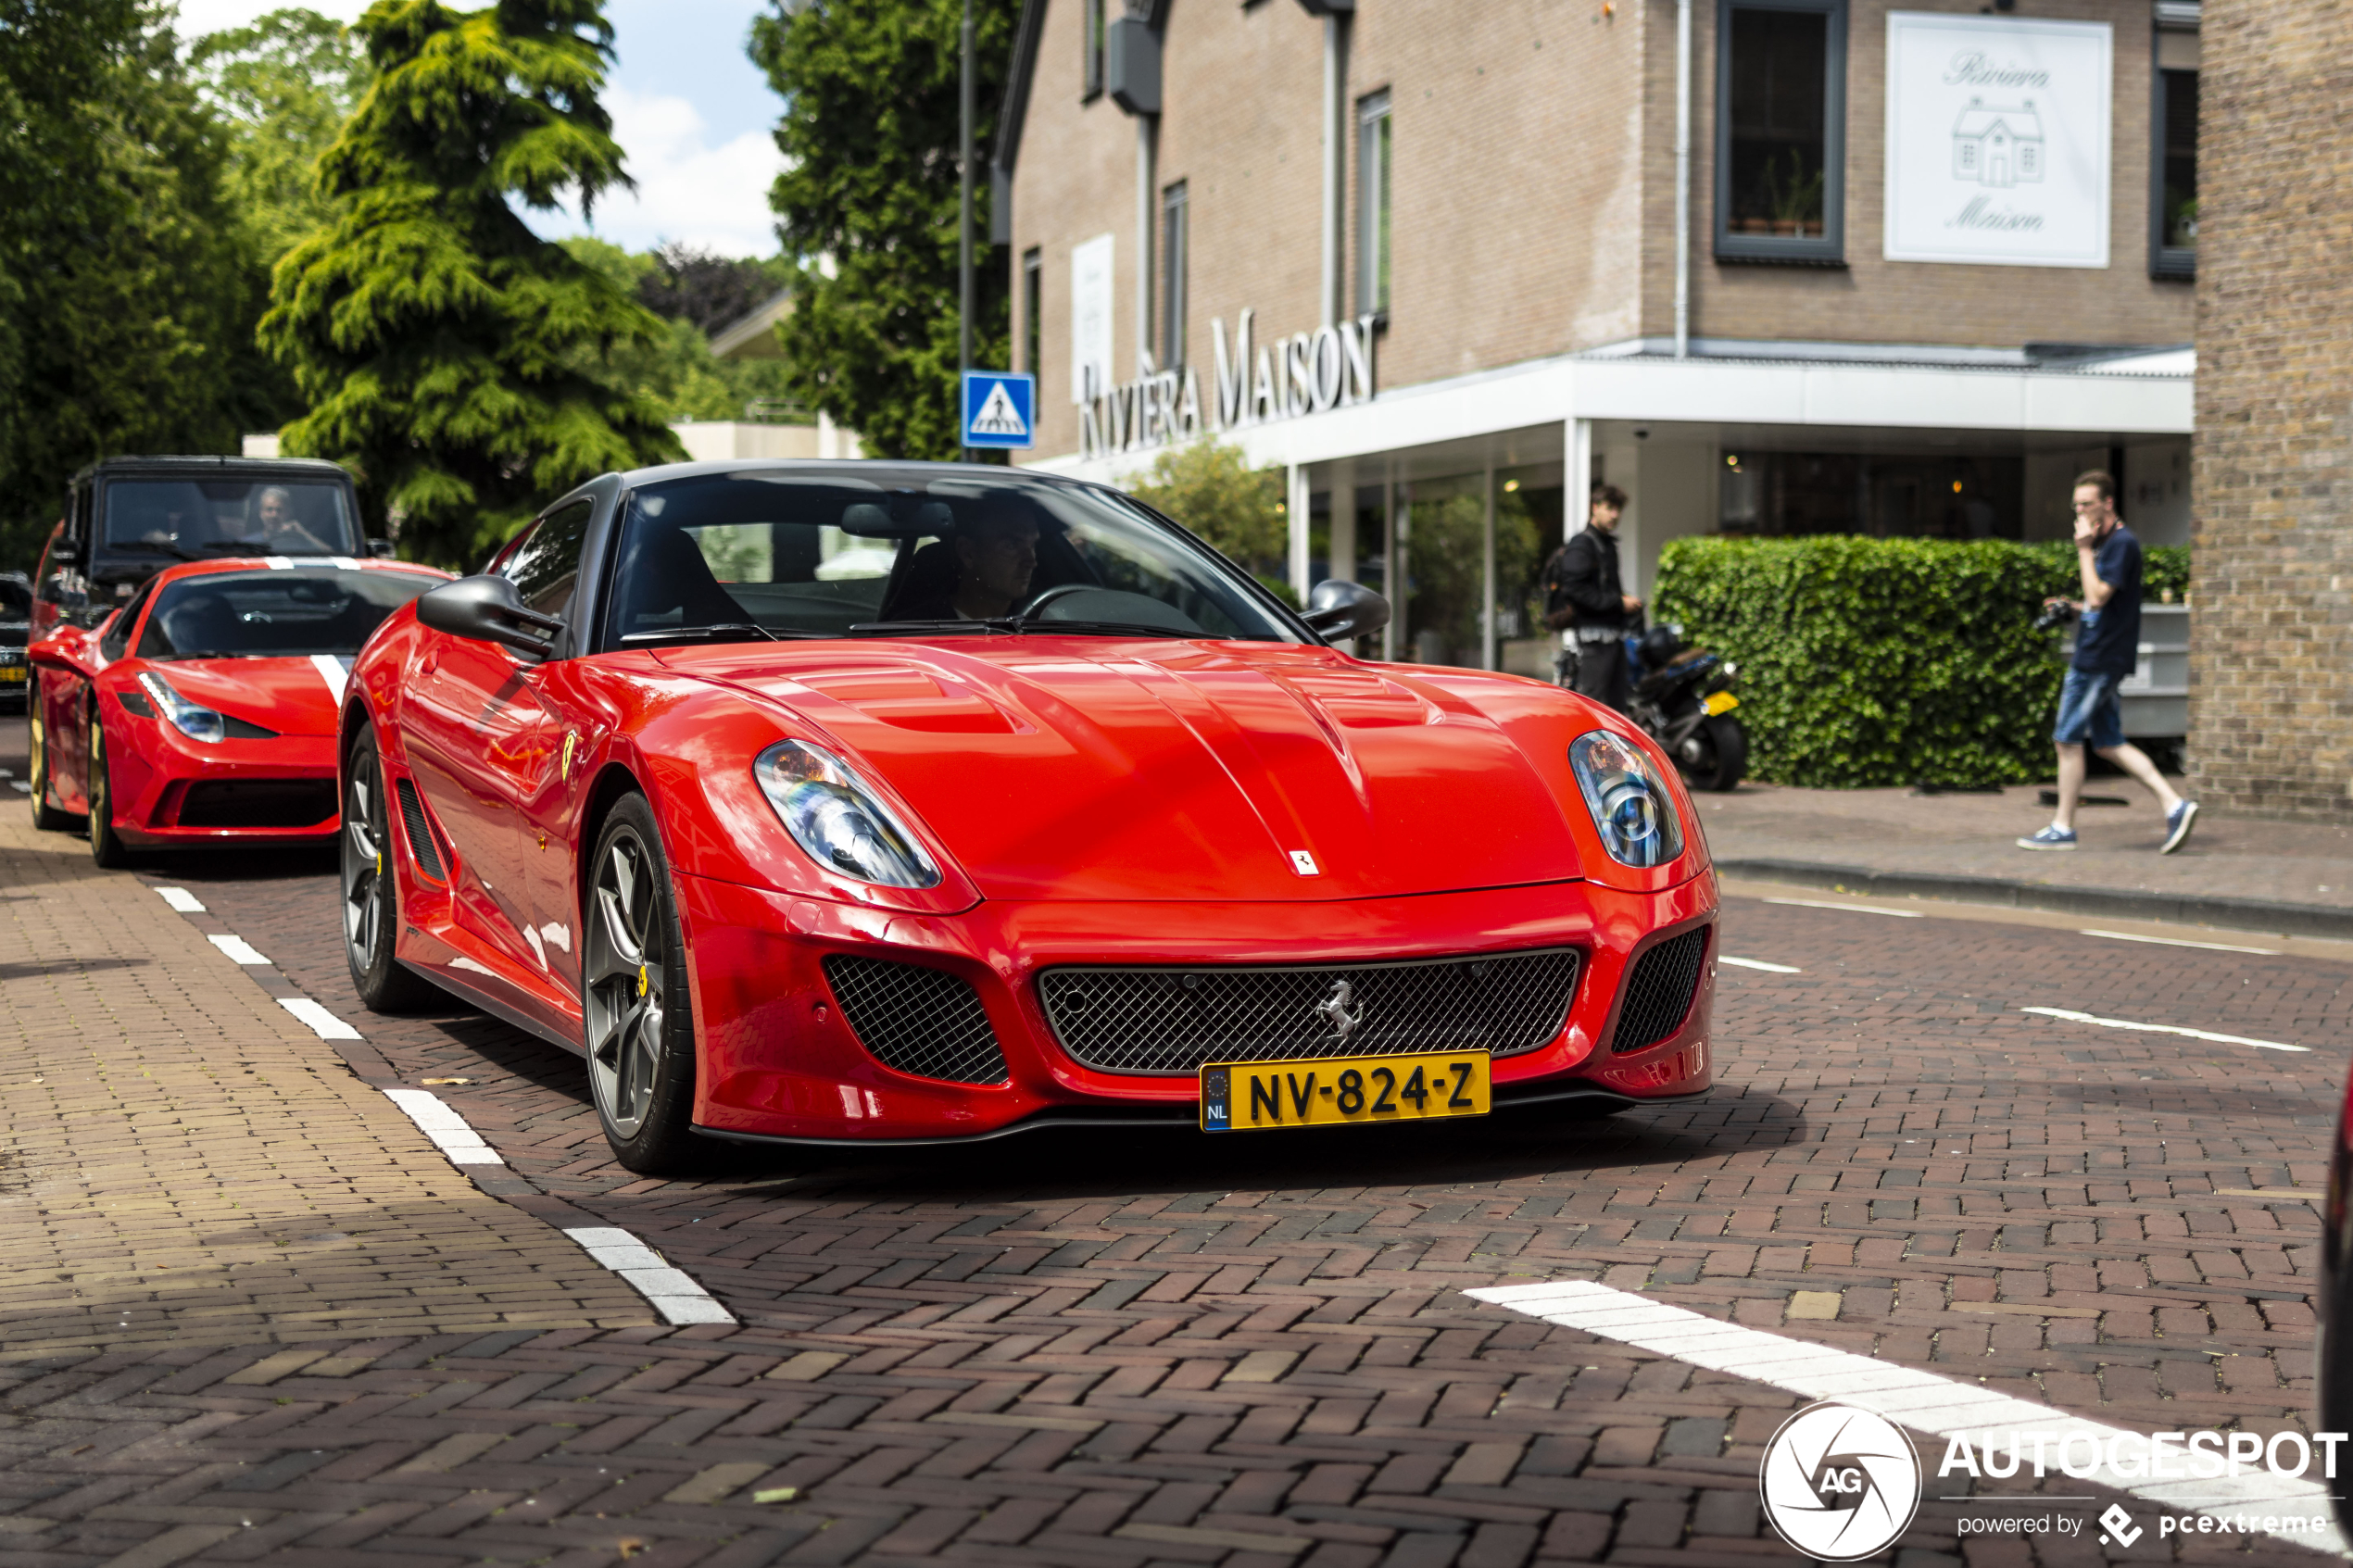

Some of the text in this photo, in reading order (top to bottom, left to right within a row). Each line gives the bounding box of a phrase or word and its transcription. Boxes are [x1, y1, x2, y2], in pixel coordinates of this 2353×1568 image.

[1944, 193, 2045, 232] Maison
[1211, 307, 1377, 433] MAISON
[1207, 1105, 1227, 1120] NL
[1251, 1062, 1473, 1121] NV-824-Z
